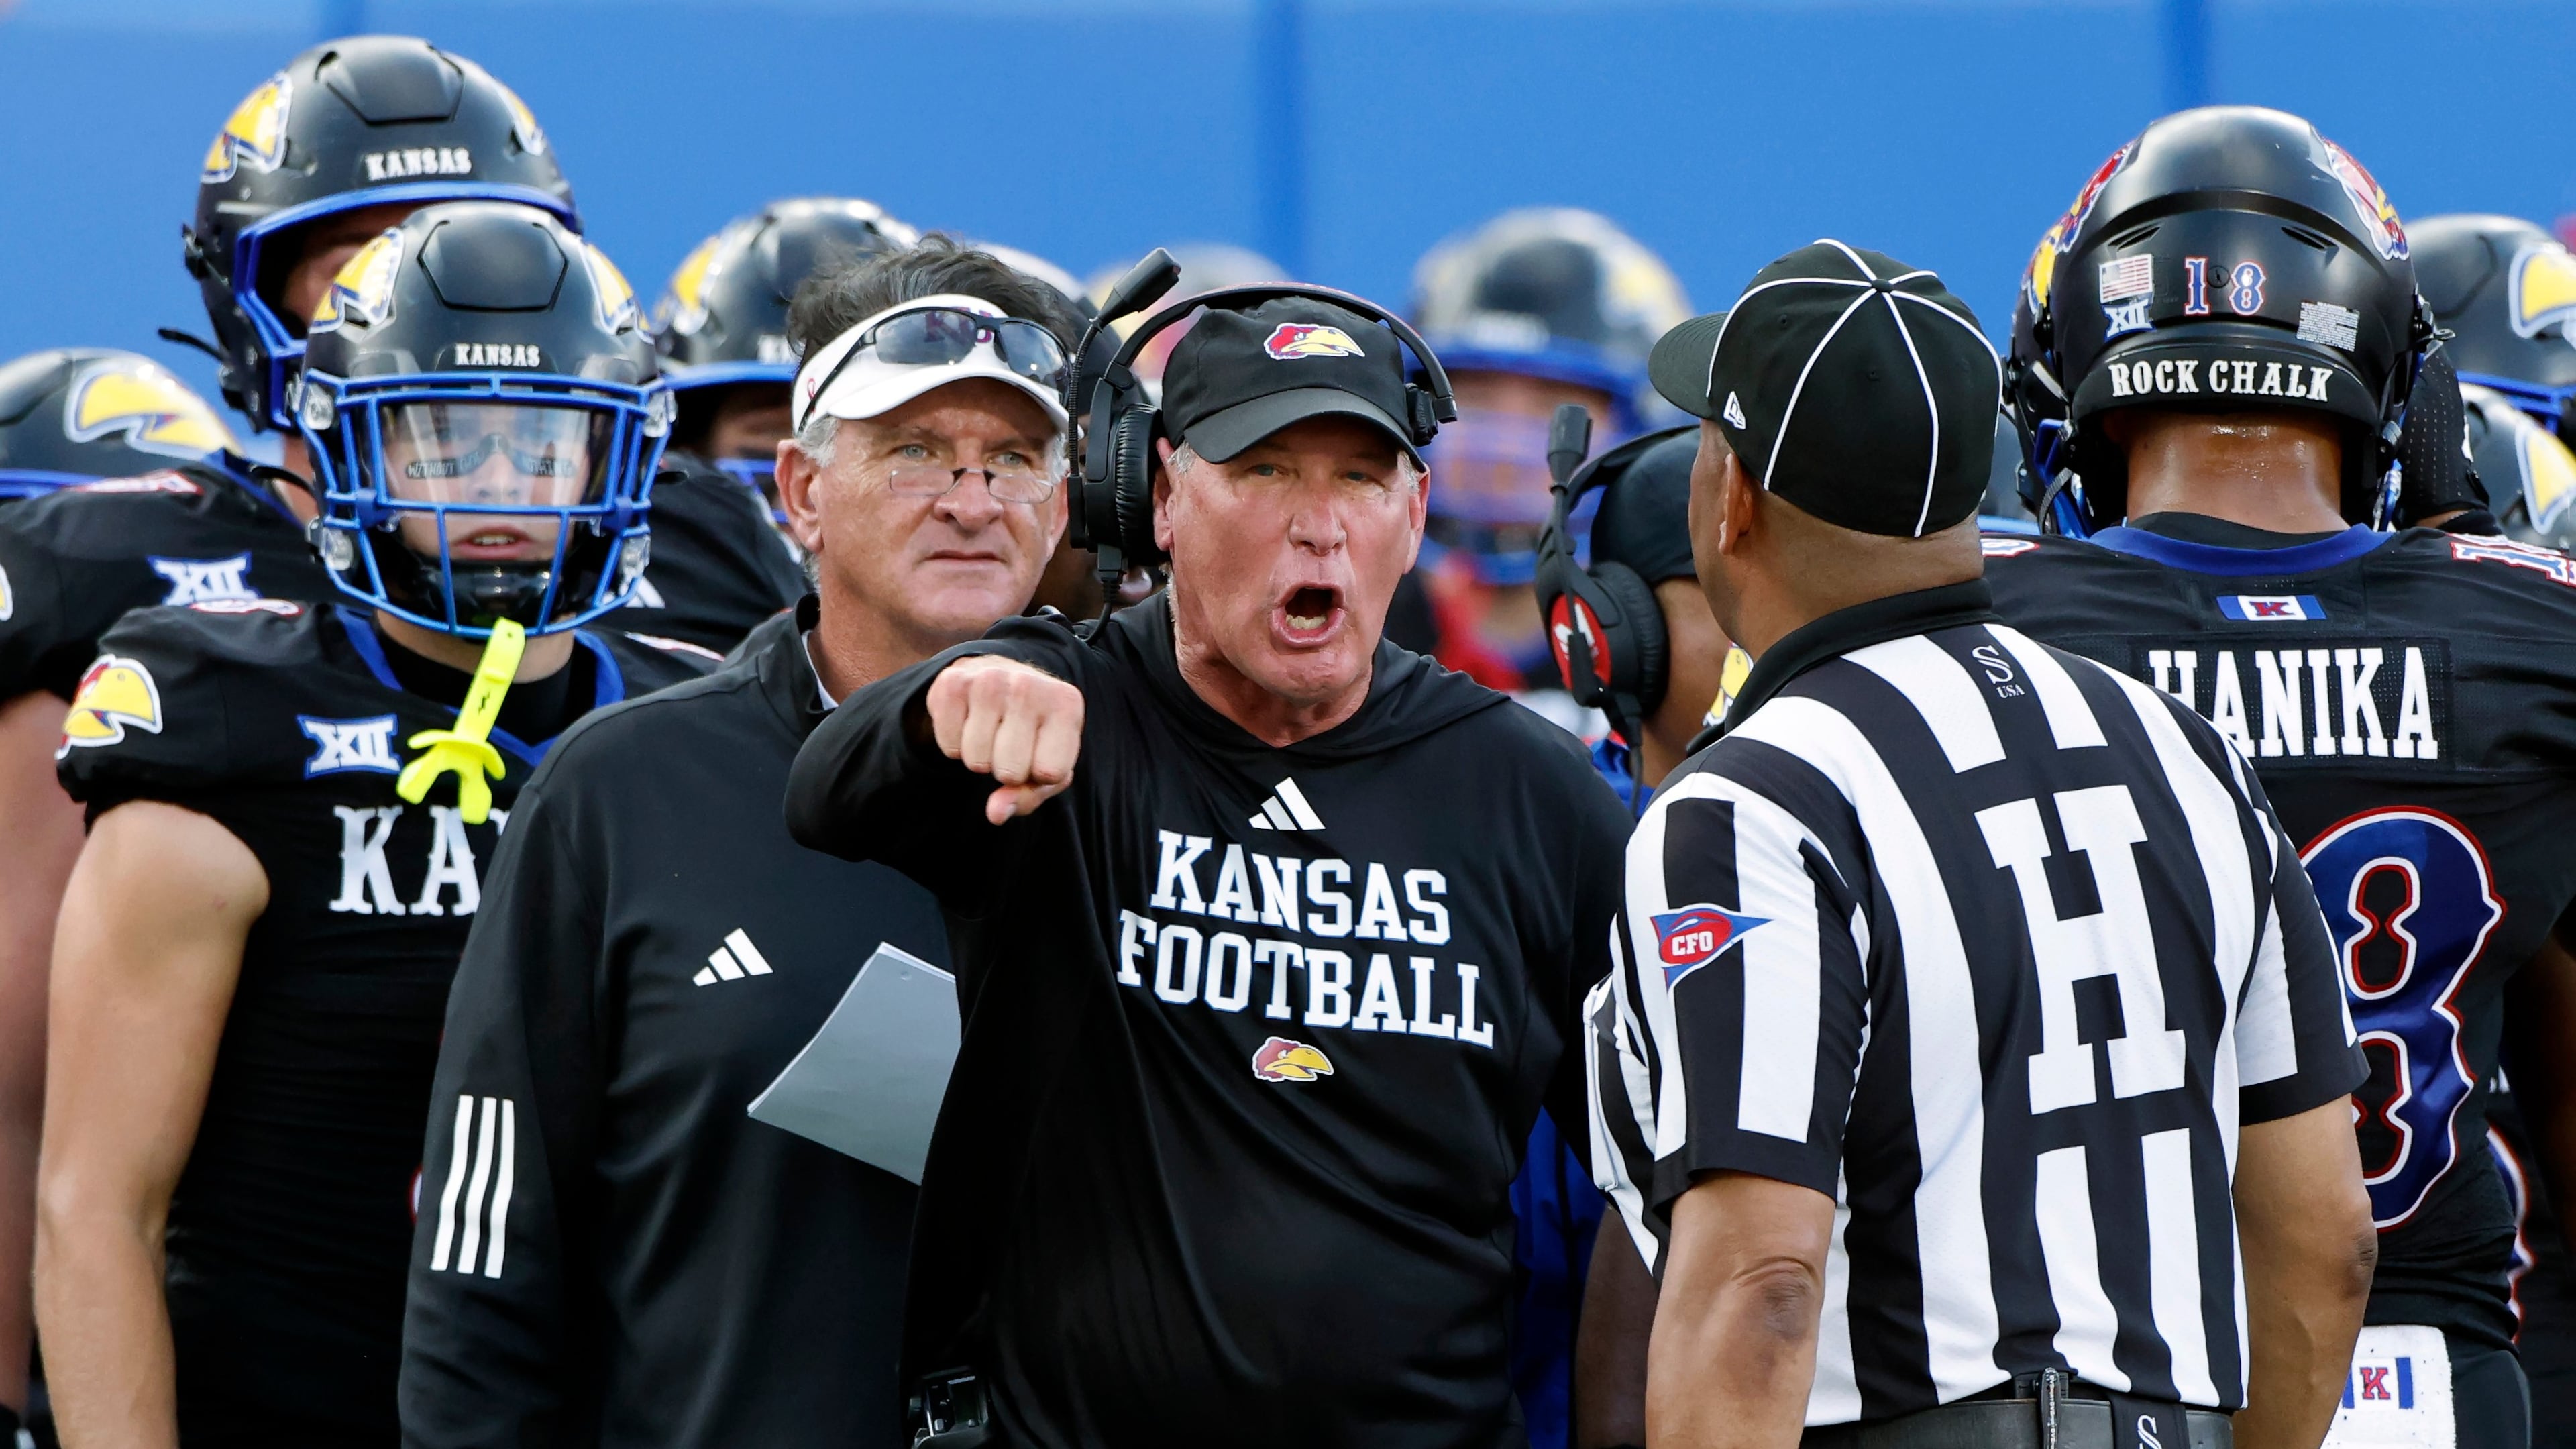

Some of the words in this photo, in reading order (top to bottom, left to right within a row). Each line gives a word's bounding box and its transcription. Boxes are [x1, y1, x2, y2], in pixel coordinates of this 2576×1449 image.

[365, 148, 472, 181] KANSAS
[2104, 298, 2154, 339] XII
[455, 343, 541, 366] KANSAS
[2108, 360, 2199, 397] ROCK
[2208, 360, 2334, 402] CHALK
[2249, 601, 2295, 617] K
[1996, 684, 2025, 698] USA
[298, 719, 401, 773] XII
[328, 805, 511, 916] KA
[1149, 828, 1452, 946] KANSAS
[1672, 930, 1714, 957] CFO
[1974, 784, 2186, 1115] H
[1116, 908, 1494, 1049] FOOTBALL
[2359, 1366, 2391, 1400] K
